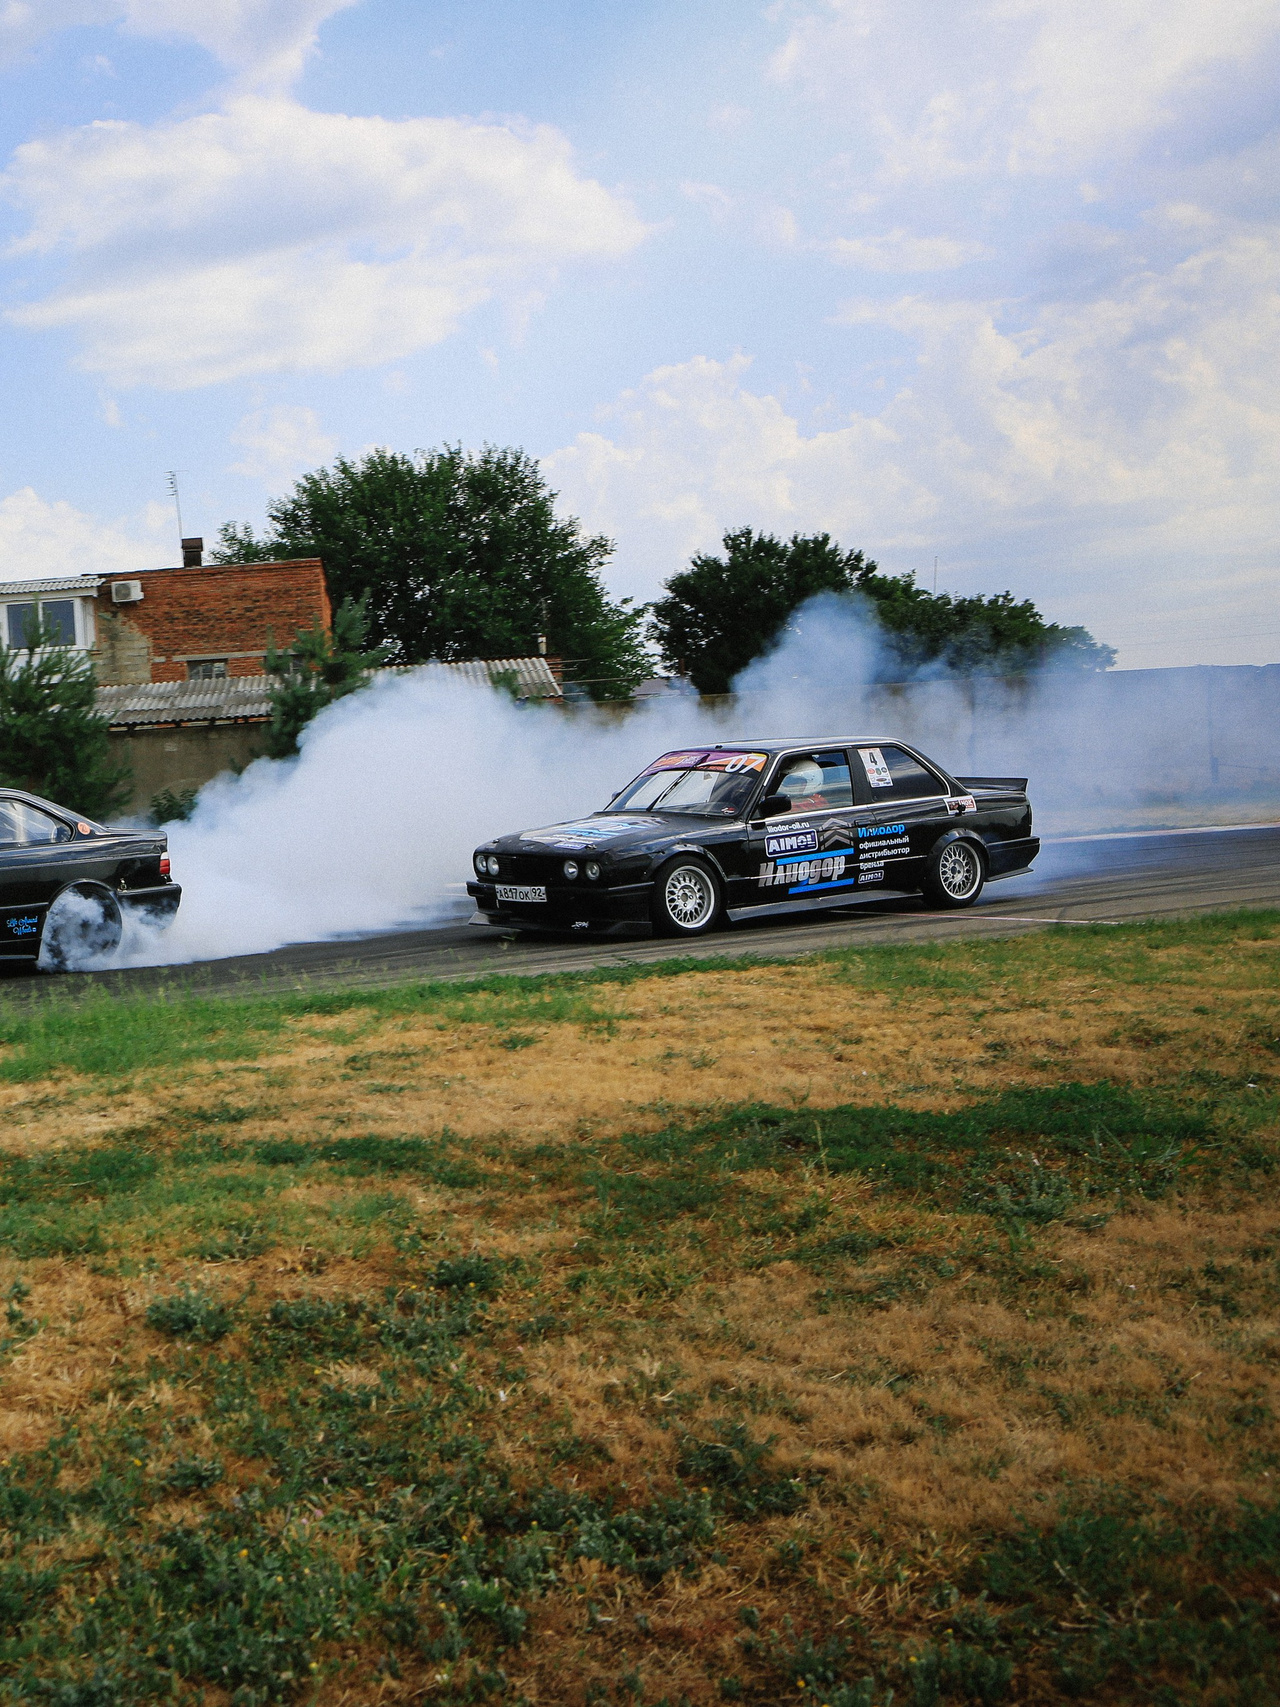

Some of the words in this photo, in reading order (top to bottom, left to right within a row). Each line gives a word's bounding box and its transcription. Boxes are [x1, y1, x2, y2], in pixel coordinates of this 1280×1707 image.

[724, 755, 766, 774] 07
[869, 752, 878, 766] 4
[857, 824, 906, 838] Илиодор
[768, 832, 816, 853] AIMOL
[859, 835, 910, 850] официальный
[859, 847, 910, 860] дистрибьютор
[859, 872, 883, 883] AIMOL
[531, 887, 543, 897] 92
